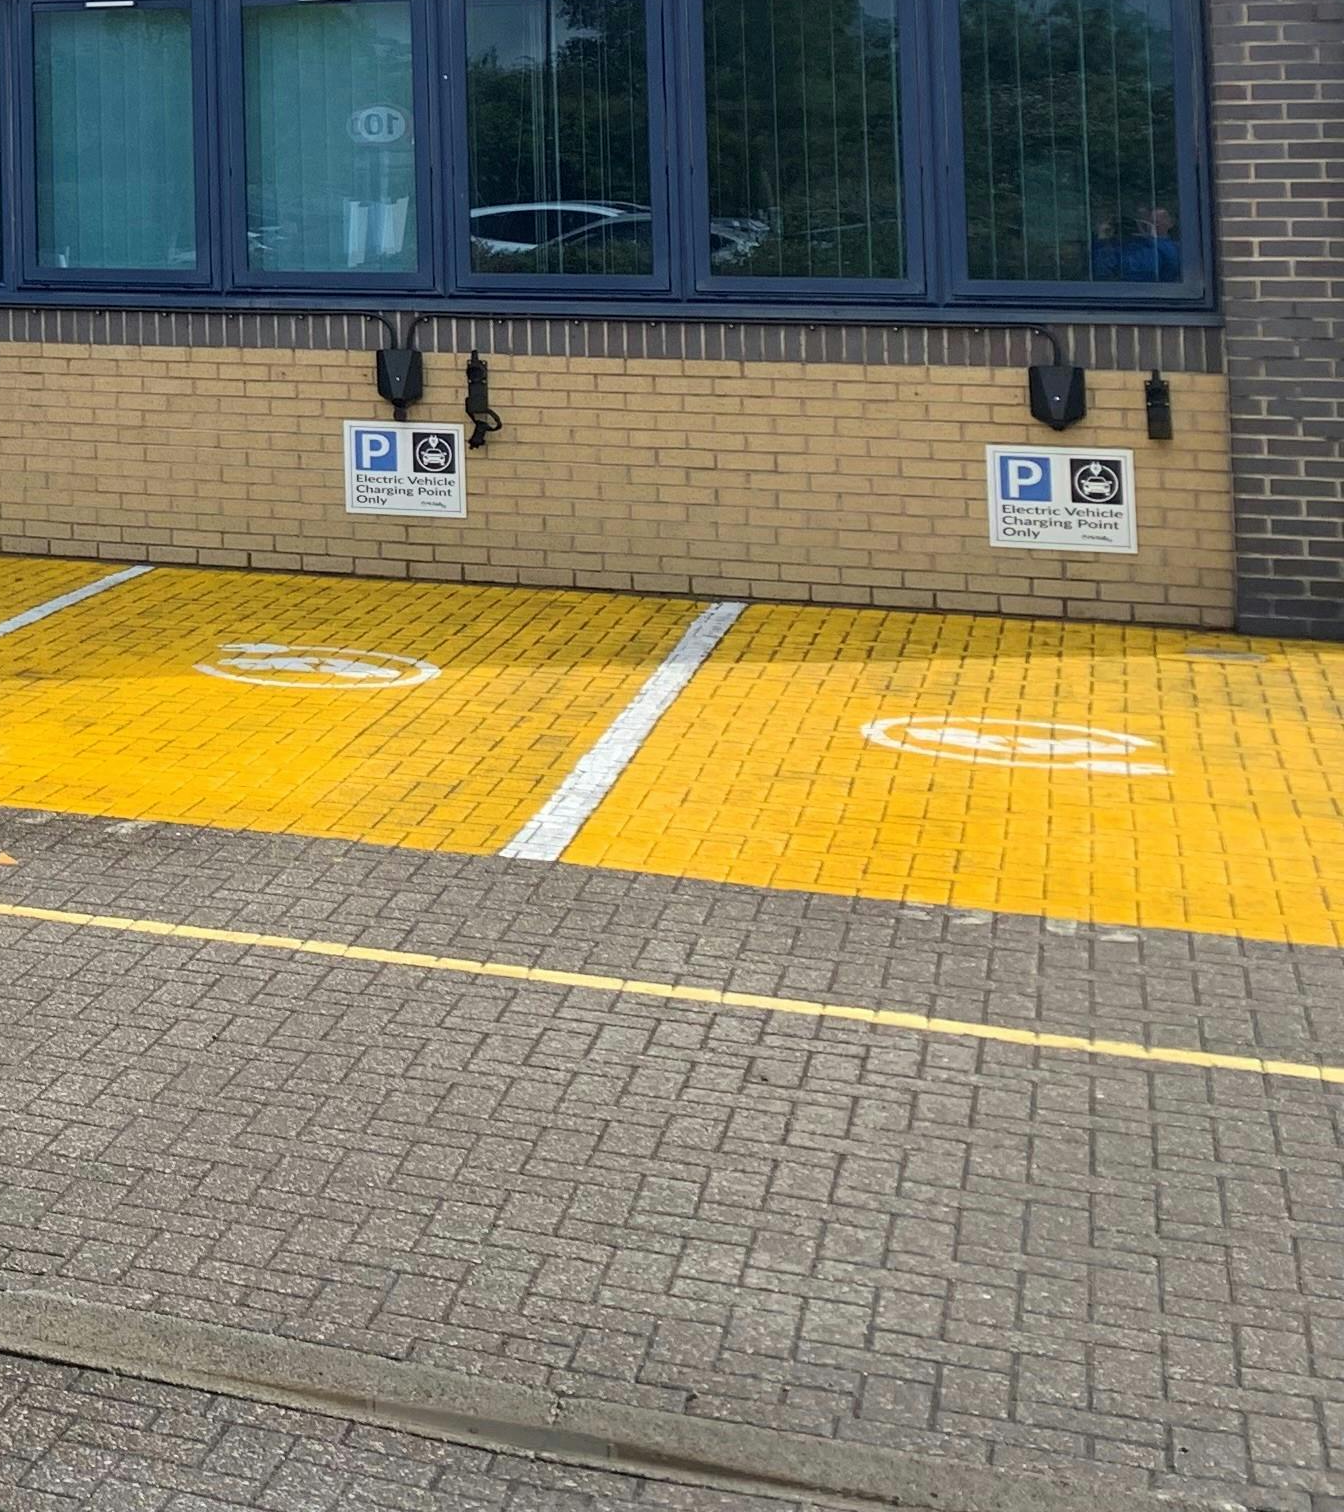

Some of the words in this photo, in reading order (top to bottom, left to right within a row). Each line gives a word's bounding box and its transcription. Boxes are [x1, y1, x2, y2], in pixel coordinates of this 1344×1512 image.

[362, 433, 390, 468] P
[356, 474, 405, 485] Electric
[407, 476, 456, 487] Vehicle
[1008, 459, 1043, 498] P
[356, 484, 414, 497] Charging
[418, 487, 453, 497] Point
[356, 495, 388, 506] Only
[1002, 504, 1062, 516] Electric
[1064, 507, 1125, 519] Vehicle
[1002, 515, 1073, 530] Charging
[1077, 519, 1120, 531] Point
[1002, 527, 1041, 539] Only
